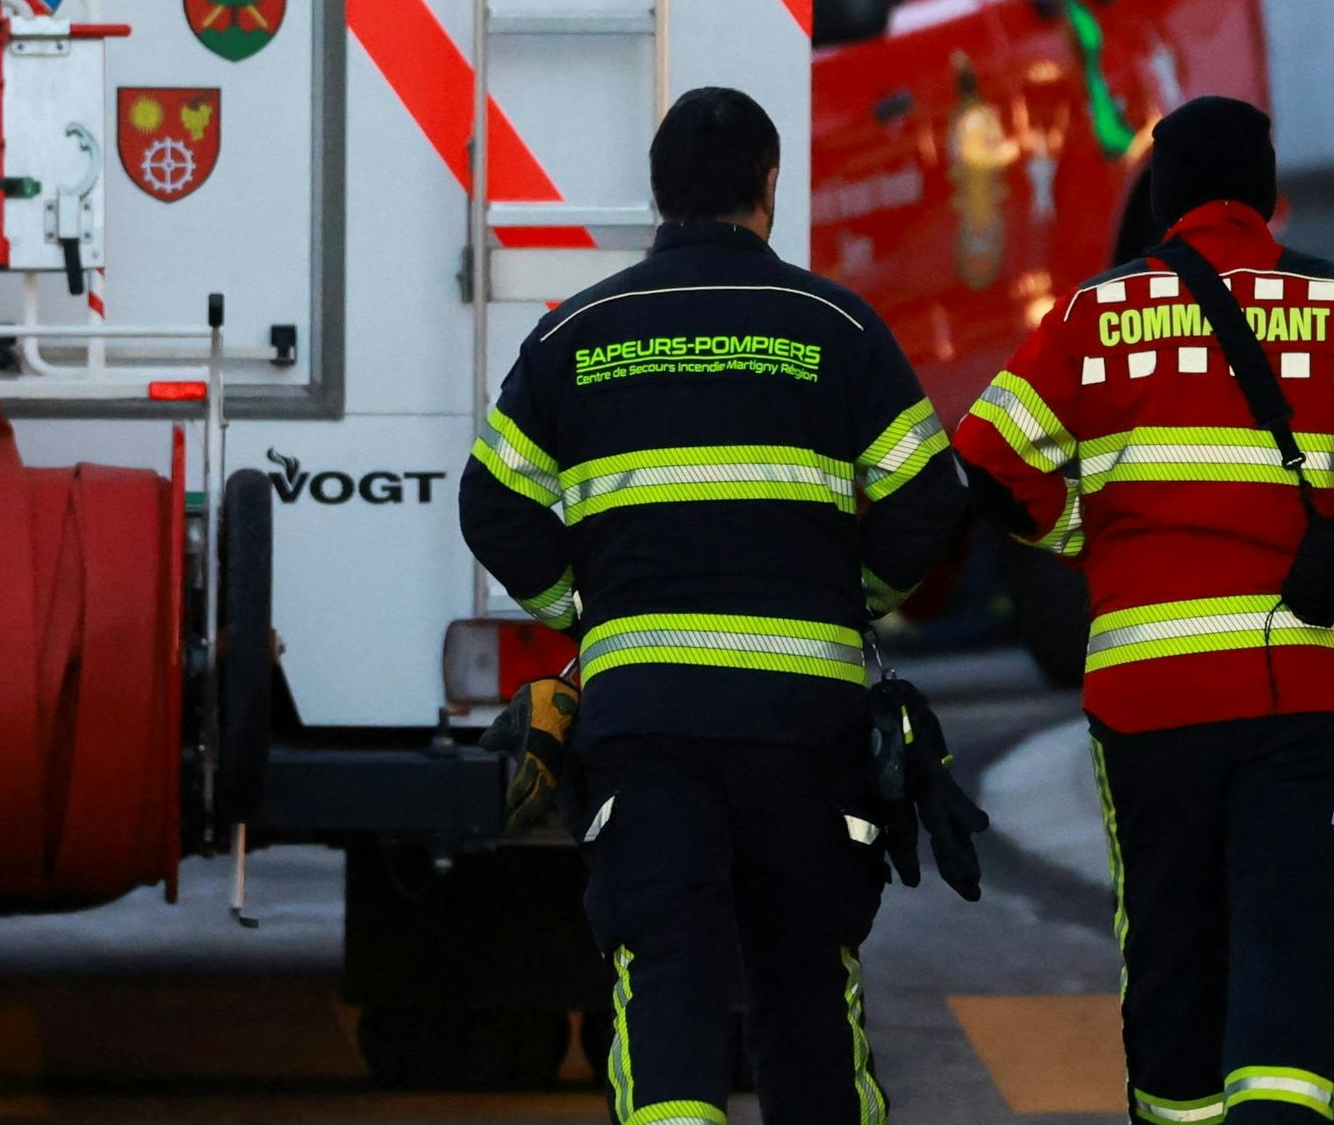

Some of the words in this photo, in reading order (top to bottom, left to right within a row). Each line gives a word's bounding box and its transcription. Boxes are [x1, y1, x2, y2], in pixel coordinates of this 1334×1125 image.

[1098, 303, 1330, 347] COMMDANT
[575, 335, 821, 367] SAPEURS-POMPIERS
[576, 371, 611, 386] Centre
[613, 366, 627, 378] de
[629, 362, 676, 375] Secours
[678, 360, 726, 373] Incendie
[727, 359, 779, 375] Martigny
[780, 363, 818, 383] Région
[267, 469, 447, 505] VOGT
